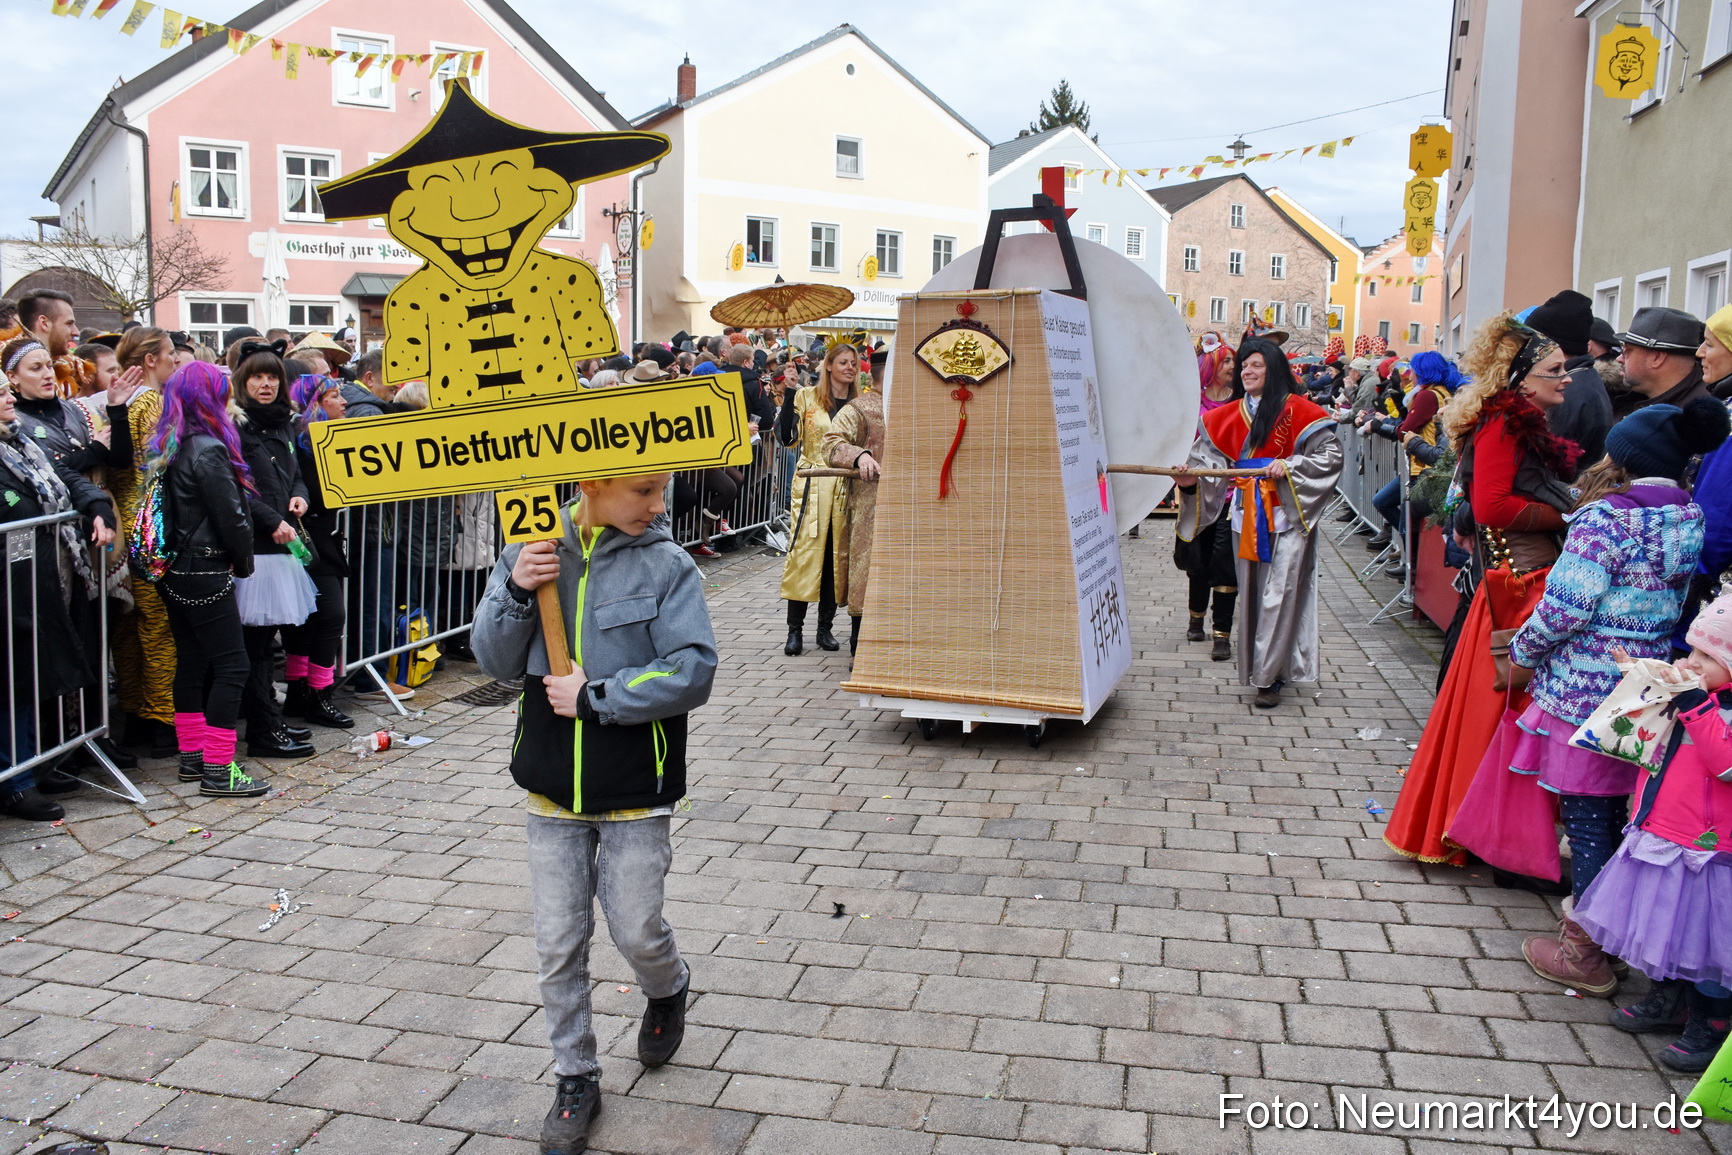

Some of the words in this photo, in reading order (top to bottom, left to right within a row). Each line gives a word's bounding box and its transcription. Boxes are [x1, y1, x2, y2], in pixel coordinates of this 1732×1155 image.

[286, 239, 345, 258] Gasthof
[350, 245, 374, 260] zur
[335, 441, 403, 478] TSV
[416, 405, 715, 469] Dietfurt/Volleyball
[505, 494, 557, 537] 25
